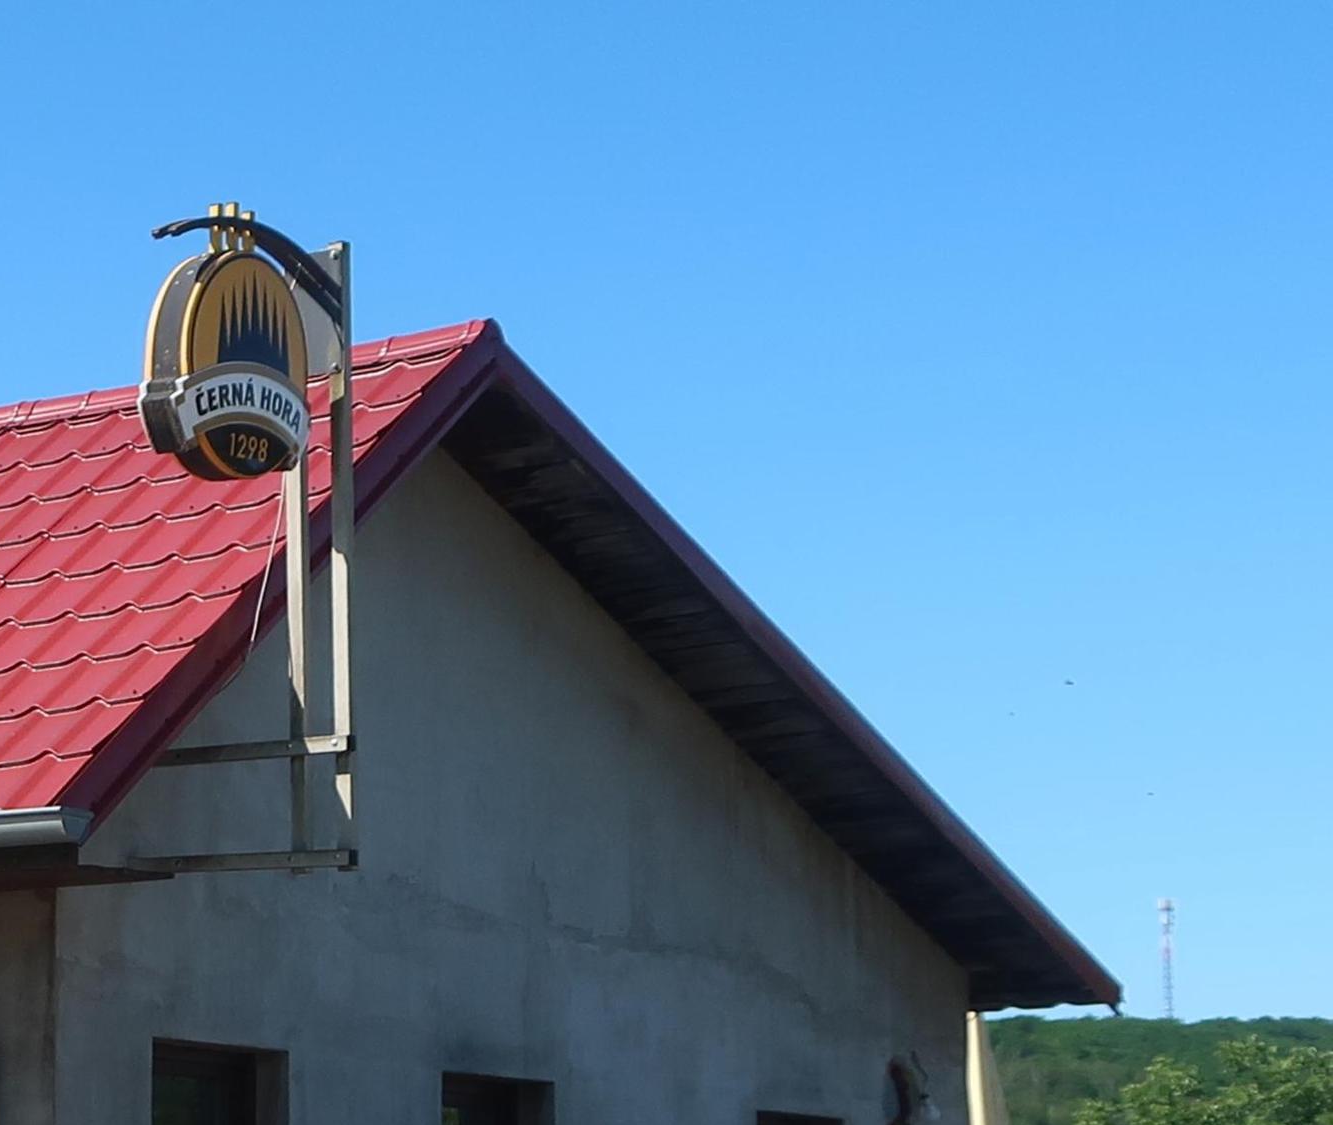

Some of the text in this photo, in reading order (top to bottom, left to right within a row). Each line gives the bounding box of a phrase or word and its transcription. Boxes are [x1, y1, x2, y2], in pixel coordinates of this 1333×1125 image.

[195, 377, 303, 433] ČERNÁ HORA
[229, 432, 269, 462] 1298
